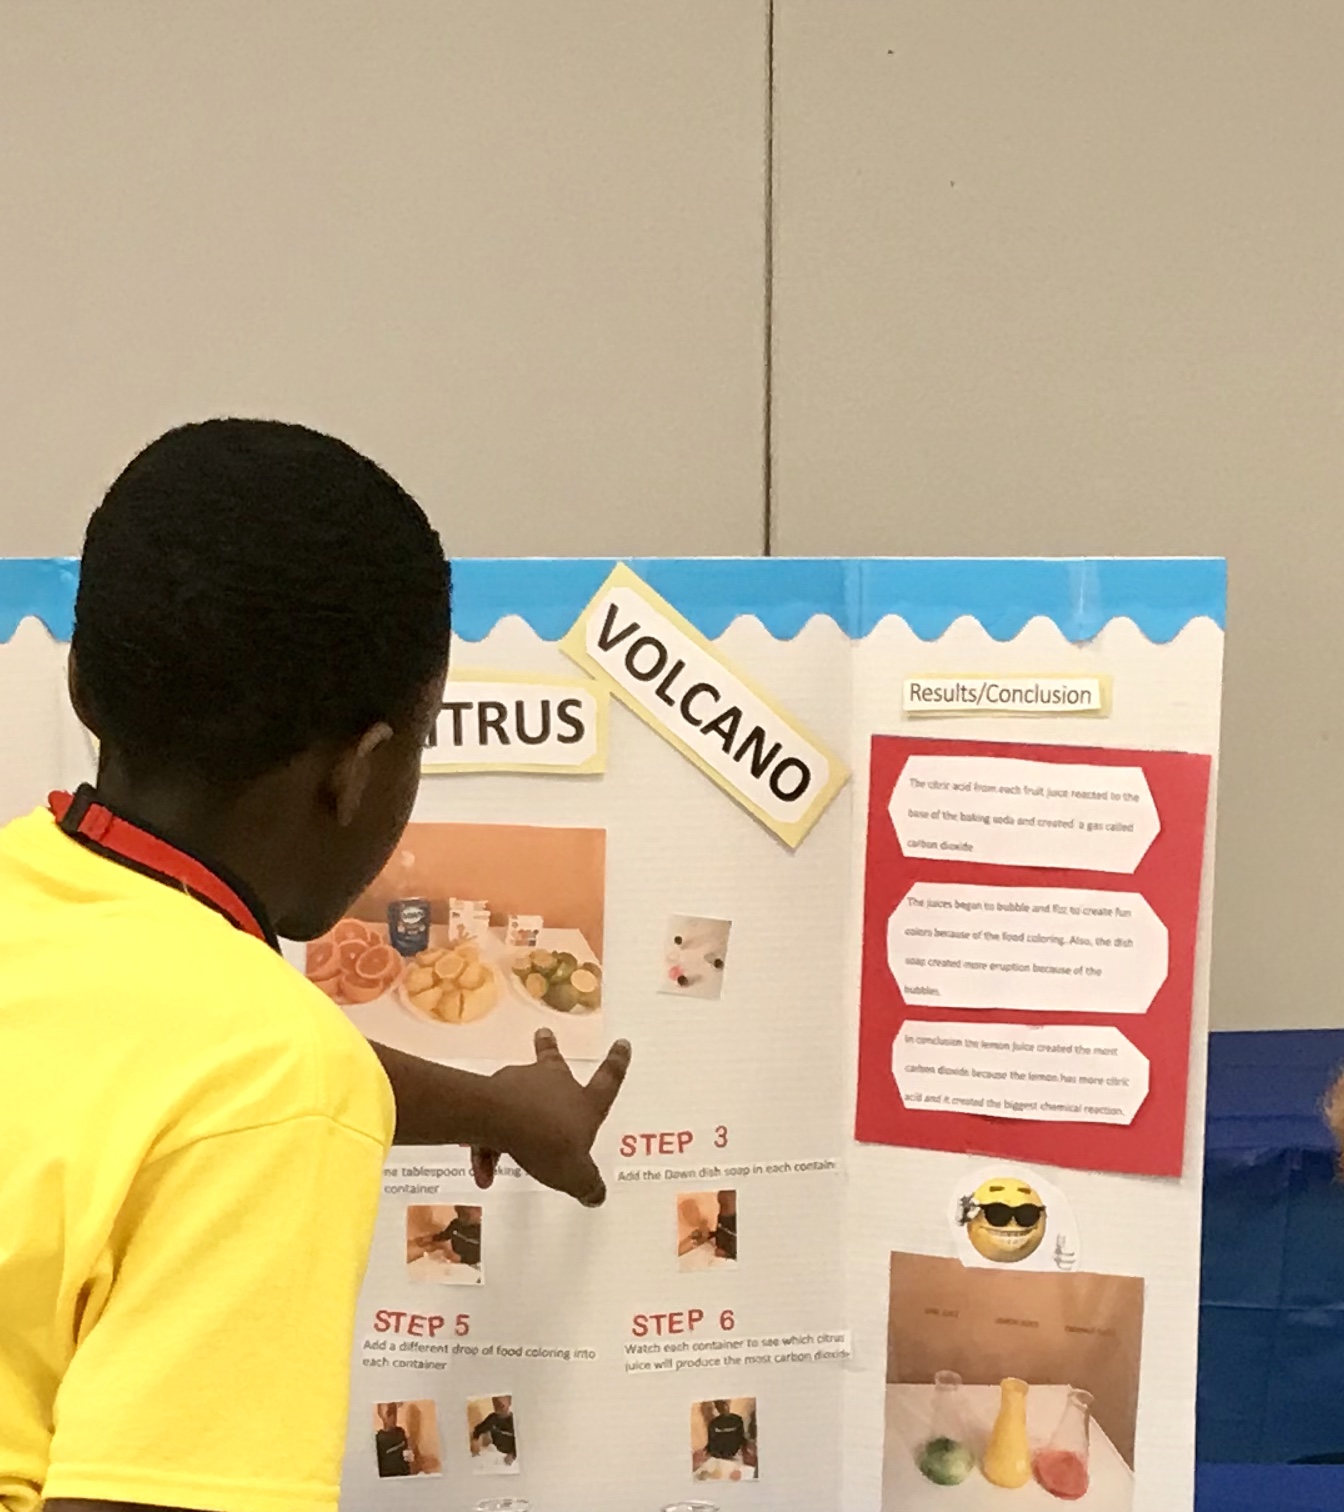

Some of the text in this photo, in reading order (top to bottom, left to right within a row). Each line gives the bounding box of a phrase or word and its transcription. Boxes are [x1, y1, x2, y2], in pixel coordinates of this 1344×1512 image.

[597, 603, 811, 802] VOLCANO
[910, 682, 1092, 705] Results/Conclusion
[424, 700, 585, 748] ITRUS
[910, 777, 925, 788] The
[998, 785, 1021, 795] each
[1024, 785, 1044, 797] fruit
[1110, 791, 1120, 800] to
[1123, 792, 1139, 802] the
[942, 810, 957, 820] the
[907, 897, 924, 907] The
[996, 902, 1029, 913] bubble
[1032, 904, 1049, 913] and
[973, 930, 981, 940] of
[984, 932, 999, 940] the
[1002, 932, 1024, 942] food
[1073, 966, 1083, 976] of
[1086, 967, 1101, 977] the
[1075, 1045, 1090, 1055] the
[1010, 1070, 1025, 1080] the
[620, 1126, 728, 1157] STEP 3
[384, 1166, 397, 1176] ne
[402, 1163, 465, 1182] tablespoon
[618, 1171, 640, 1180] Add
[643, 1170, 661, 1180] the
[699, 1167, 720, 1178] dish
[724, 1167, 750, 1178] soap
[754, 1165, 762, 1174] in
[765, 1163, 791, 1173] each
[384, 1182, 439, 1194] container
[374, 1310, 470, 1337] STEP 5
[632, 1309, 735, 1337] STEP 6
[363, 1340, 386, 1350] Add
[399, 1341, 448, 1354] different
[451, 1344, 478, 1357] drop
[482, 1344, 493, 1355] of
[497, 1345, 522, 1356] food
[525, 1347, 570, 1360] coloring
[574, 1348, 595, 1359] into
[625, 1344, 660, 1354] Watch
[664, 1342, 688, 1353] each
[693, 1339, 744, 1351] container
[747, 1339, 758, 1347] to
[762, 1339, 778, 1347] see
[782, 1334, 814, 1346] which
[363, 1357, 446, 1370] each container
[625, 1360, 650, 1372] juice
[654, 1359, 672, 1369] will
[676, 1357, 720, 1371] produce
[724, 1356, 741, 1365] the
[744, 1355, 771, 1364] most
[774, 1353, 811, 1363] carbon
